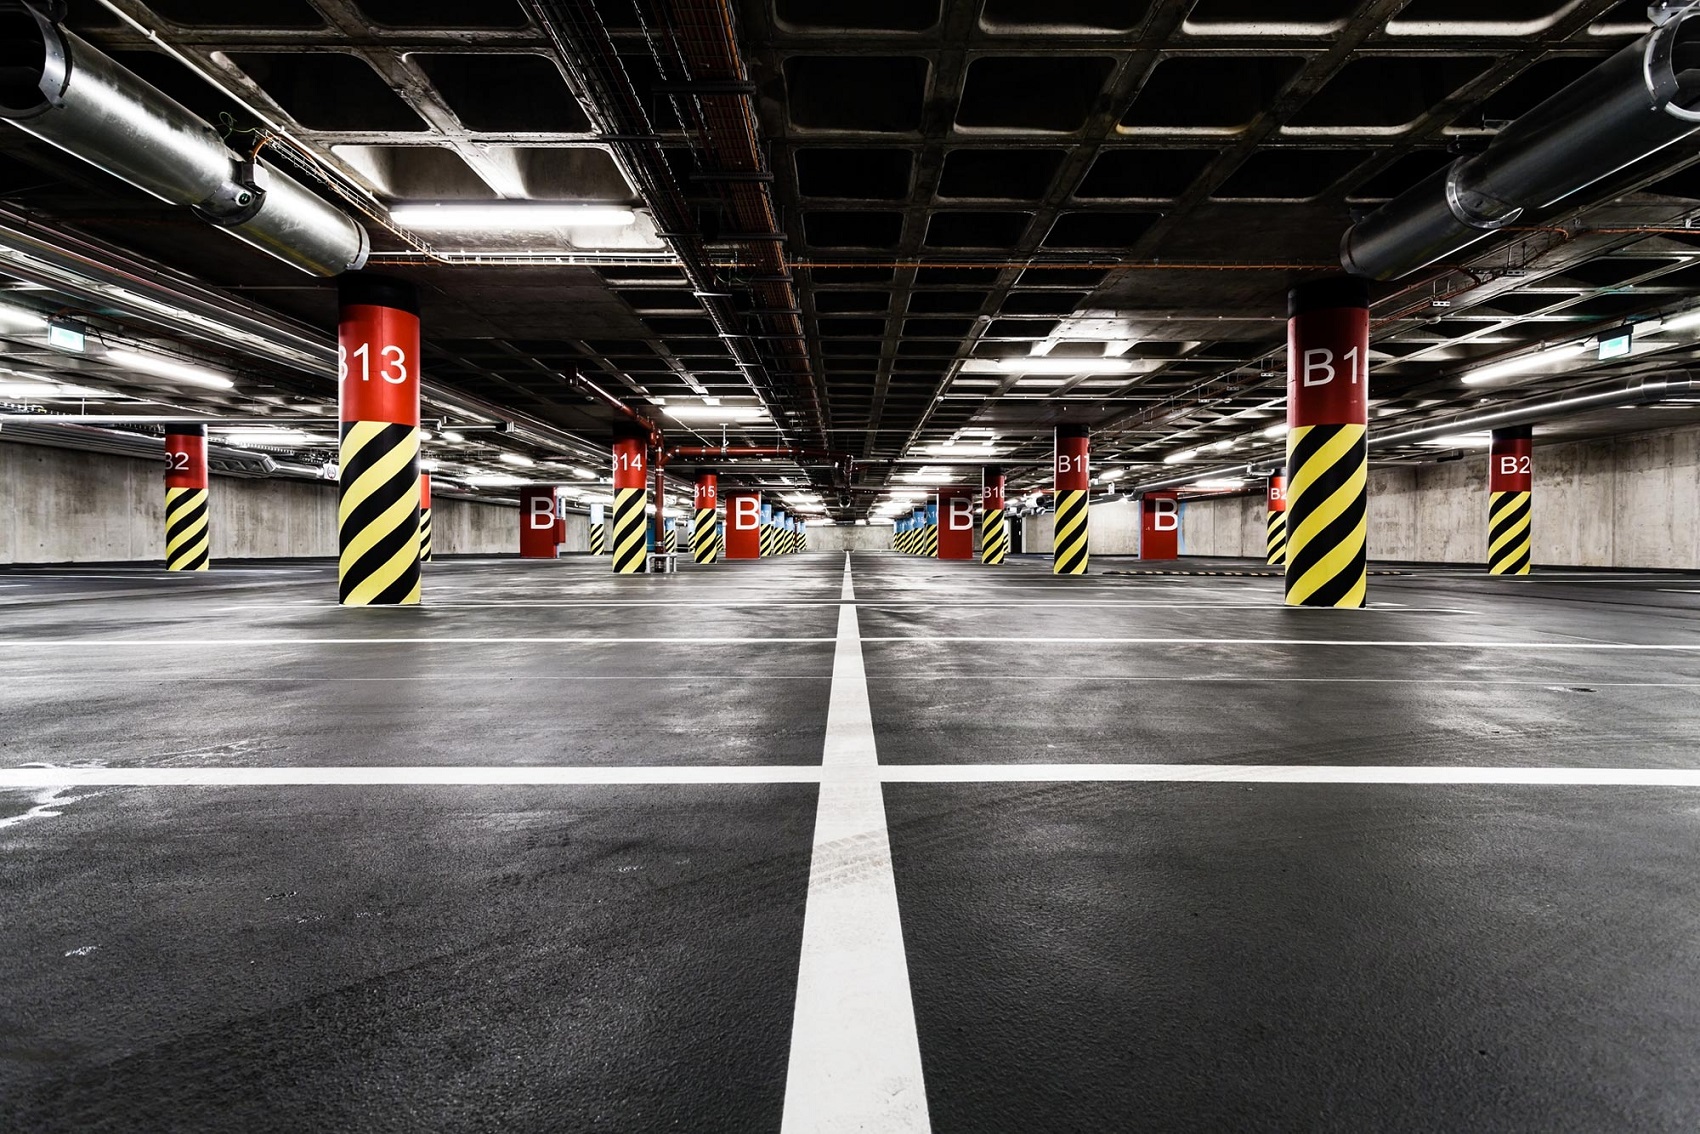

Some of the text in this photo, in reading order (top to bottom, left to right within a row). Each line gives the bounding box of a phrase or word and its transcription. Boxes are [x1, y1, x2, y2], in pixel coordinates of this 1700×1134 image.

[531, 496, 555, 529] B
[735, 497, 760, 530] B
[950, 497, 973, 530] B
[1154, 498, 1178, 531] B
